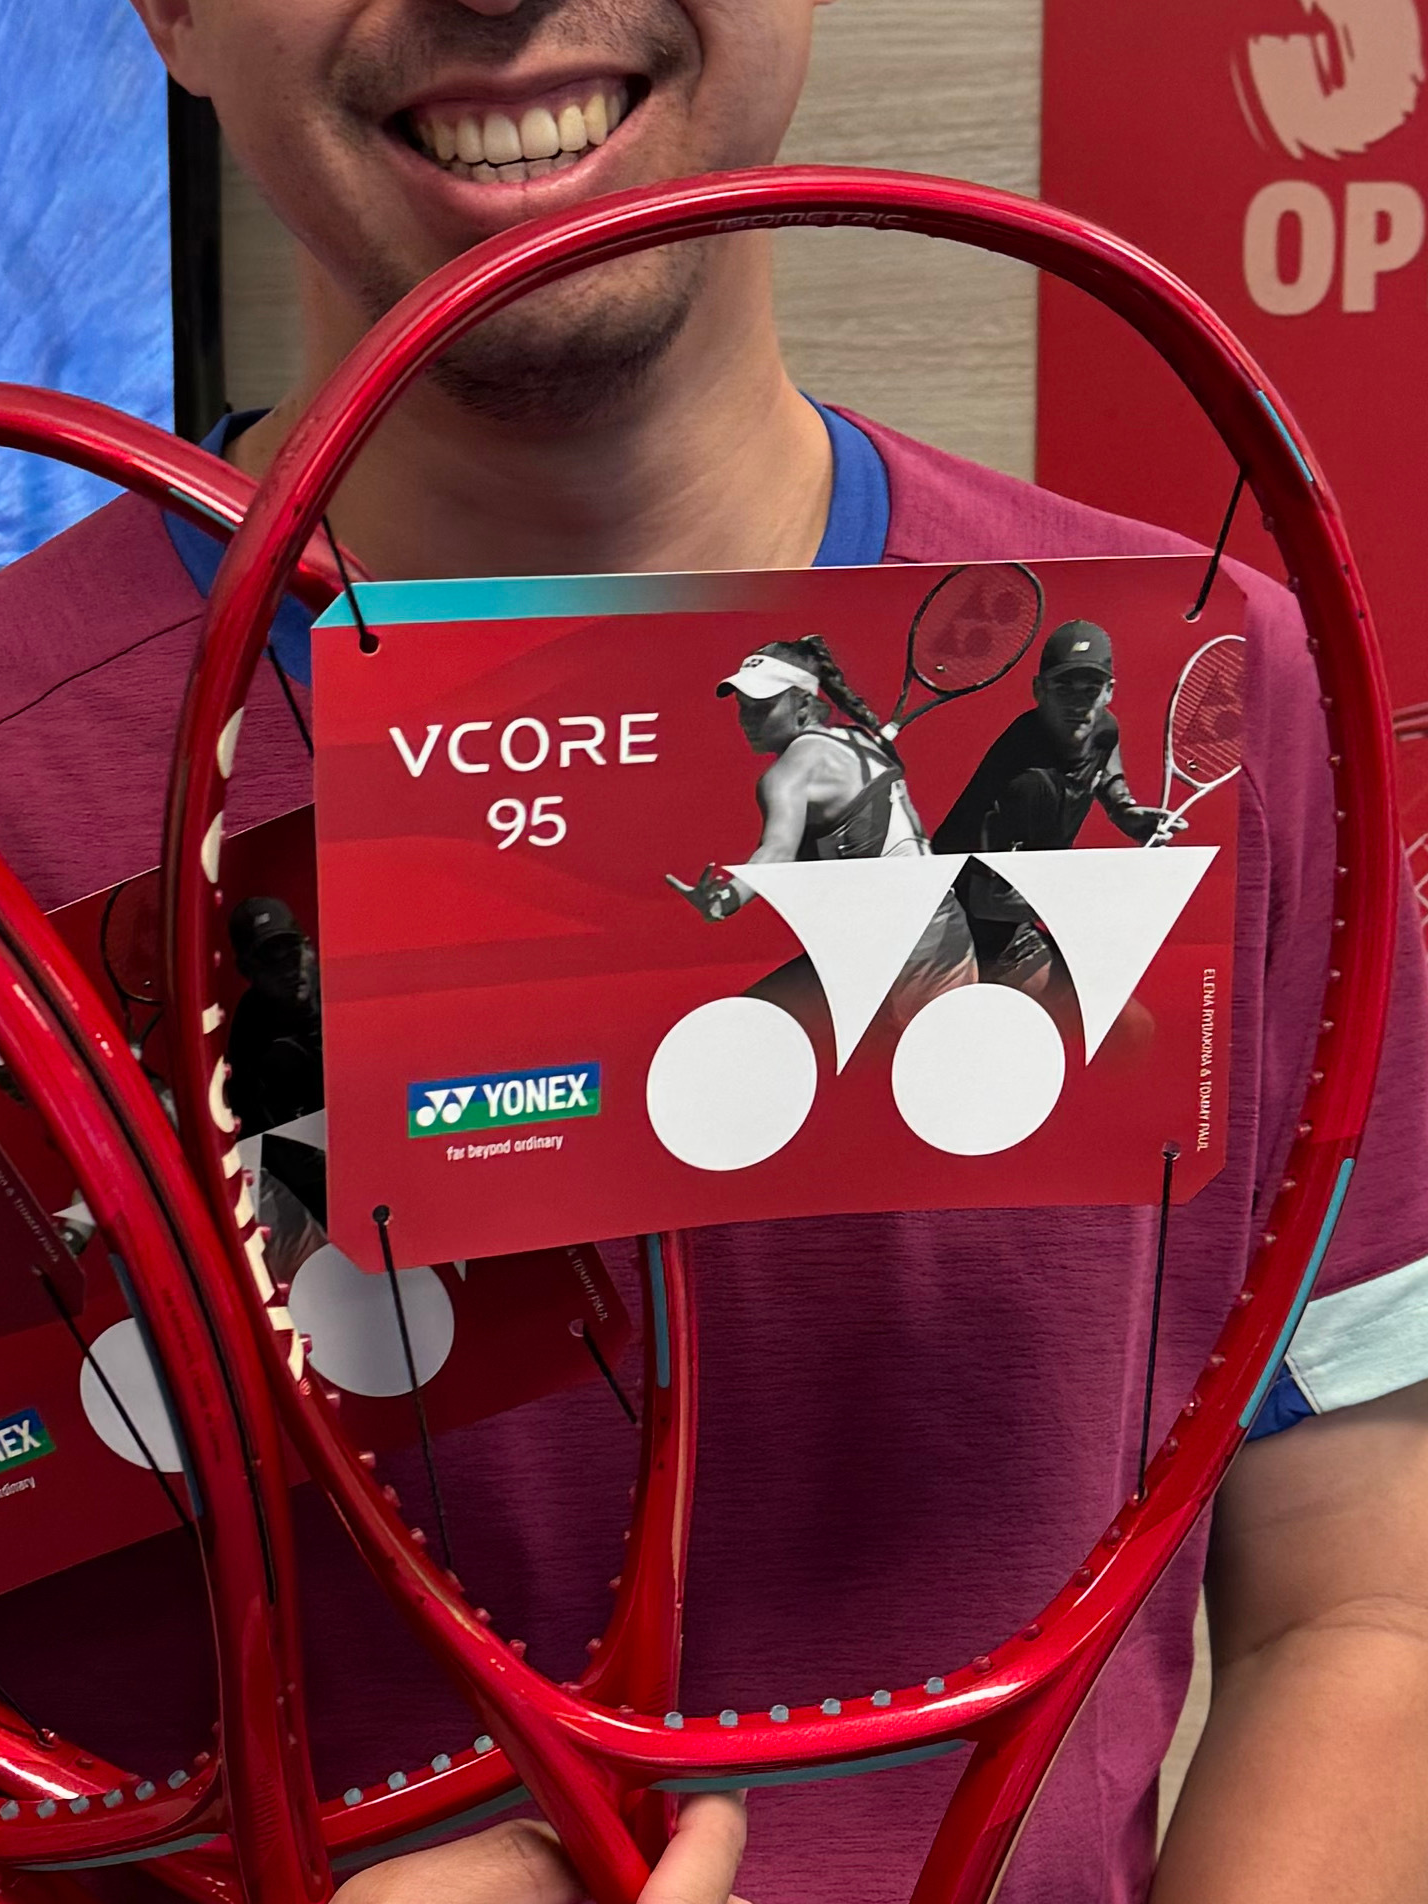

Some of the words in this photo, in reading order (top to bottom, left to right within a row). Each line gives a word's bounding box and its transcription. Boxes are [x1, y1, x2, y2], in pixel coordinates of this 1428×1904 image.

[388, 712, 660, 778] VCORE
[486, 795, 568, 850] 95
[481, 1072, 589, 1118] YONEX
[445, 1144, 466, 1162] far
[467, 1138, 512, 1160] beyond
[514, 1134, 565, 1153] ordinary
